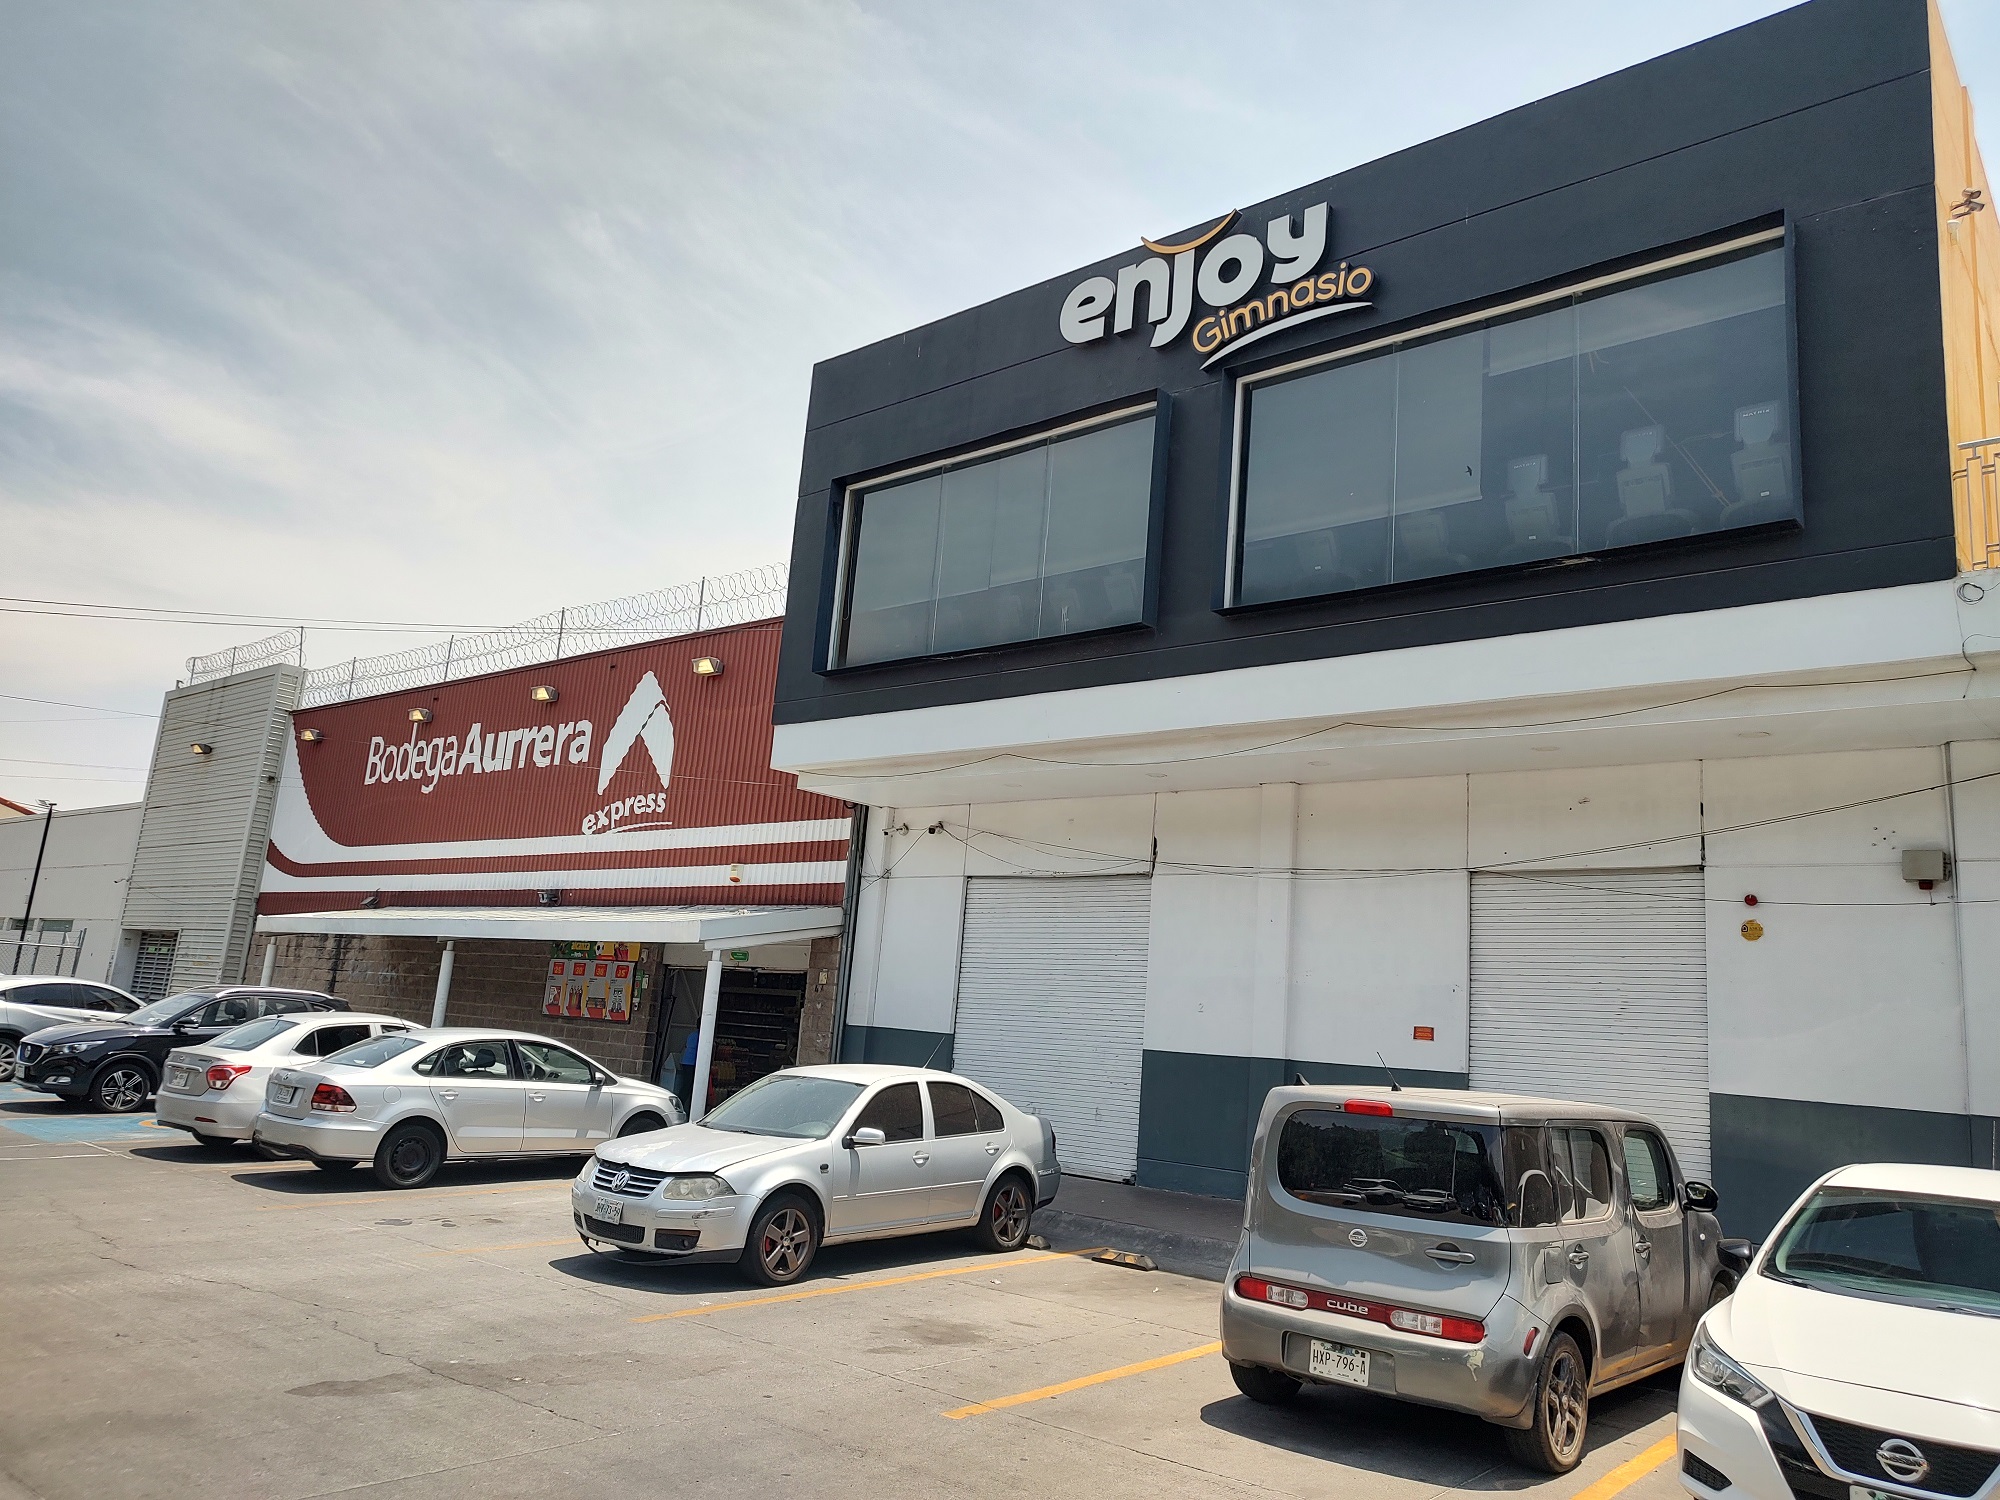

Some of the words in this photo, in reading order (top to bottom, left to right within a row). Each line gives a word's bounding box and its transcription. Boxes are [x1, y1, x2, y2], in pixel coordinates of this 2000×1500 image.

[1059, 201, 1328, 348] enjoy
[1192, 261, 1373, 353] Gimnasio
[364, 722, 458, 794] Bodega
[457, 719, 593, 775] Aurrera
[581, 792, 667, 835] express
[1327, 1300, 1368, 1314] cube
[1313, 1349, 1366, 1375] HXP-796-A
